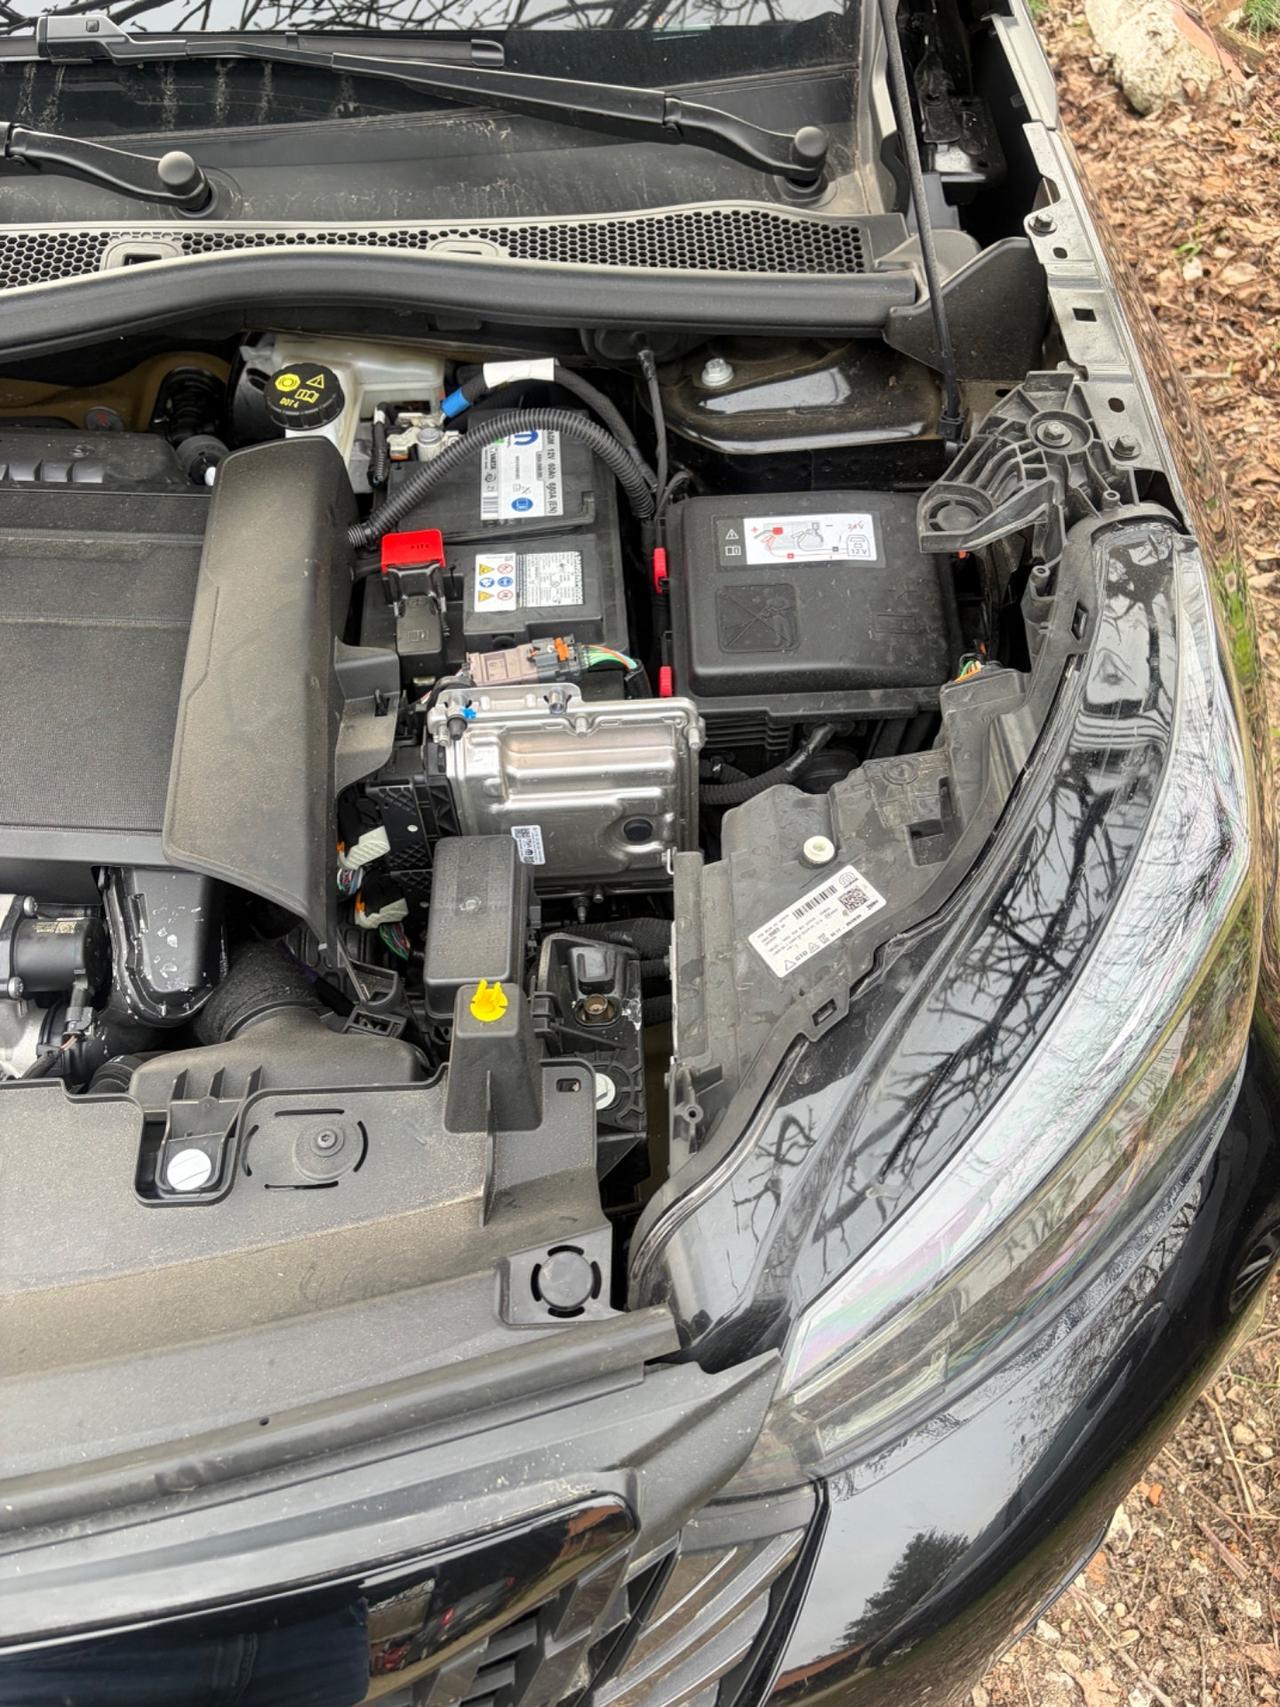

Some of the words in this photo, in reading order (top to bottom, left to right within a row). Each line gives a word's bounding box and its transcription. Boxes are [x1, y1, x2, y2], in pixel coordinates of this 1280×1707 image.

[280, 397, 294, 406] DOT
[547, 448, 556, 459] 12V
[548, 463, 556, 479] 60Ah
